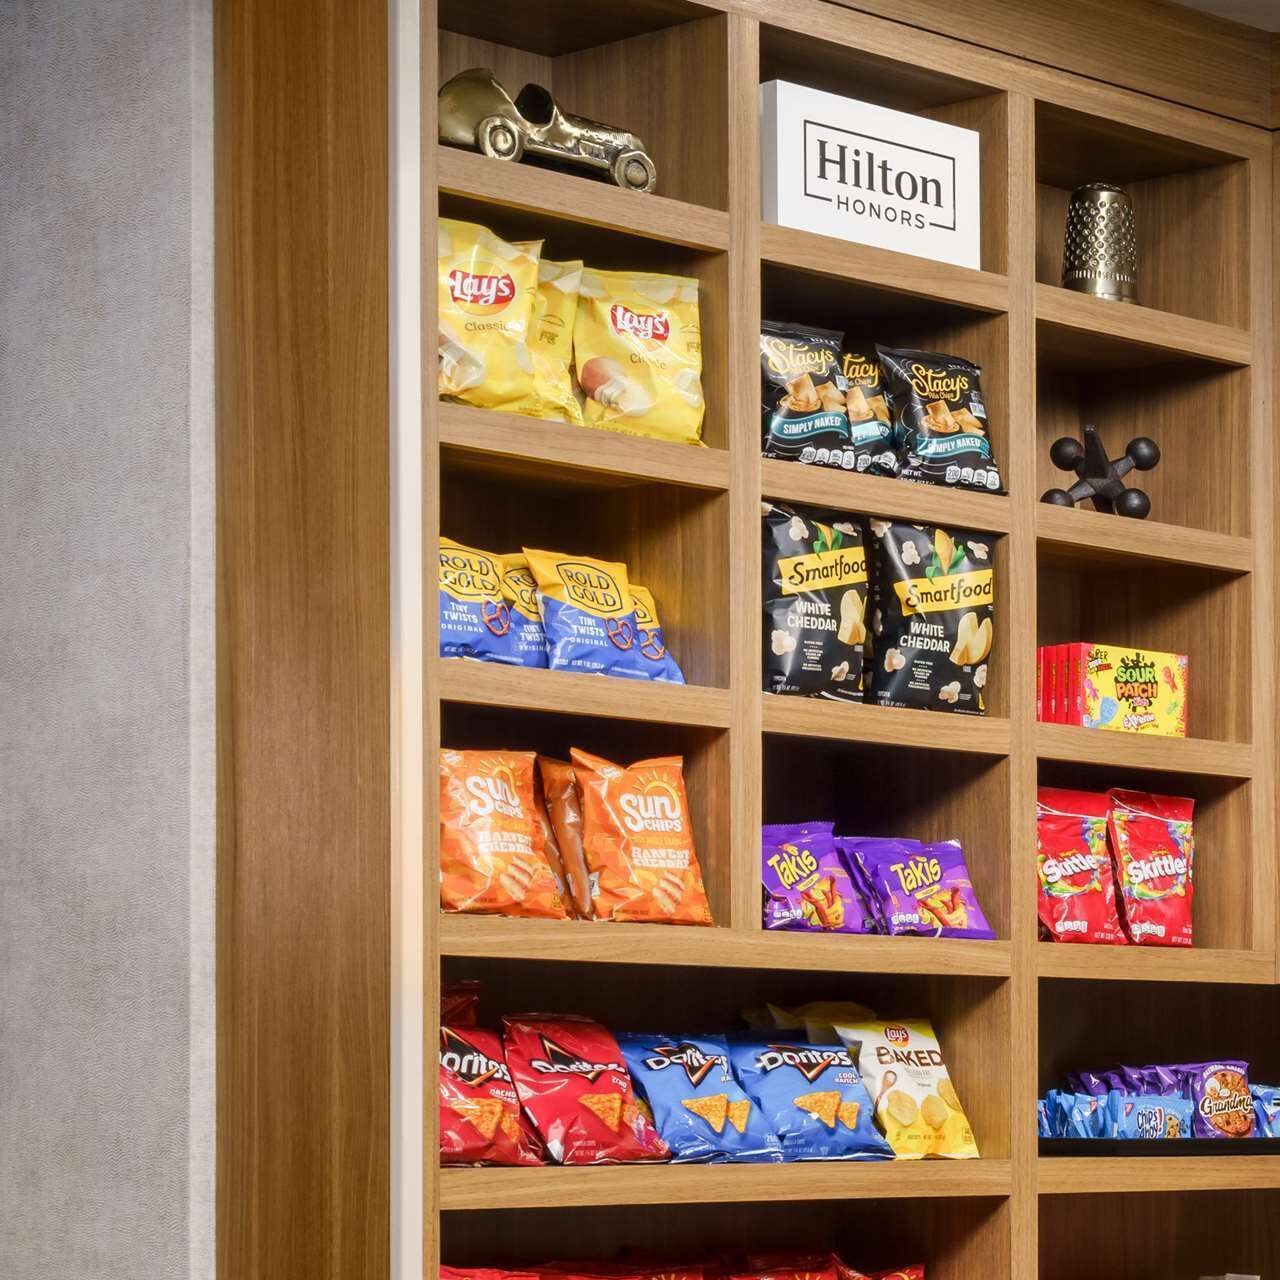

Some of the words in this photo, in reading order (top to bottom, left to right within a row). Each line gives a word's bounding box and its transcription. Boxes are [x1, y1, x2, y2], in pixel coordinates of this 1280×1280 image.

[817, 139, 944, 209] Hilton
[837, 195, 925, 230] HONORS
[450, 270, 512, 305] Lay's
[612, 305, 668, 341] Lay's
[767, 339, 834, 375] Stacy's
[843, 353, 881, 388] tacy
[911, 363, 968, 401] Stacy's
[783, 420, 814, 434] SIMPLY
[814, 416, 841, 427] NAKED
[956, 438, 982, 449] NAKED
[440, 553, 490, 576] ROLD
[443, 570, 497, 591] GOLD
[513, 573, 537, 586] RO
[565, 569, 610, 590] ROLD
[519, 588, 539, 605] GO
[571, 585, 617, 607] GOLD
[905, 578, 993, 609] Smartfood
[443, 611, 479, 624] TWISTS
[450, 602, 468, 615] TINY
[795, 601, 832, 616] WHITE
[441, 623, 483, 632] ORIGINAL
[578, 615, 596, 626] TINY
[787, 615, 838, 632] CHEDDAR
[910, 621, 945, 638] WHITE
[573, 625, 605, 637] TWISTS
[570, 636, 609, 647] ORIGINAL
[899, 635, 951, 653] CHEDDAR
[1116, 666, 1156, 683] SOUR
[1115, 682, 1158, 698] PATCH
[643, 818, 683, 833] CHIPS
[767, 848, 819, 890] Takis
[890, 857, 943, 896] Takis
[1042, 853, 1097, 883] Skittle
[886, 1028, 909, 1045] Lay's
[440, 1051, 511, 1082] oritos
[760, 1050, 850, 1071] Doritos
[875, 1047, 943, 1067] BAKED
[531, 1059, 626, 1076] Doritos
[1136, 1107, 1158, 1127] Chips
